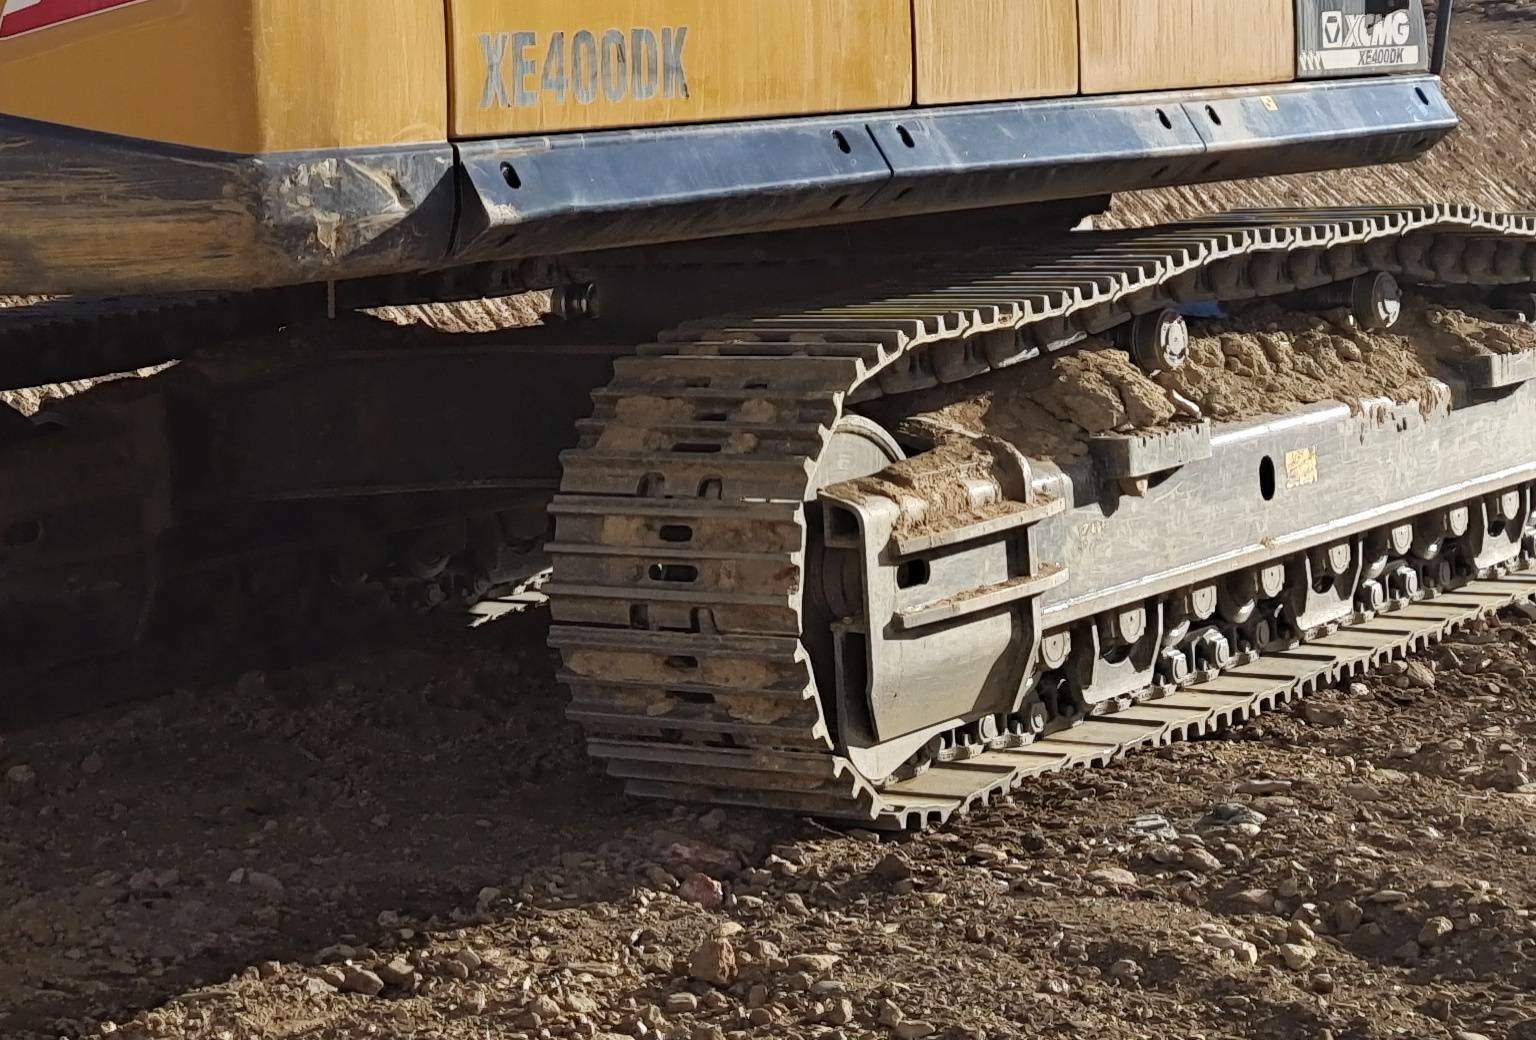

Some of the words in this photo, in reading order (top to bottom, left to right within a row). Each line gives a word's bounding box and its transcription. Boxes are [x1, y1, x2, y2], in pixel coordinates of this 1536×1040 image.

[1342, 10, 1410, 48] XCMG
[479, 26, 689, 108] XE400DK
[1358, 48, 1404, 65] XE400DK
